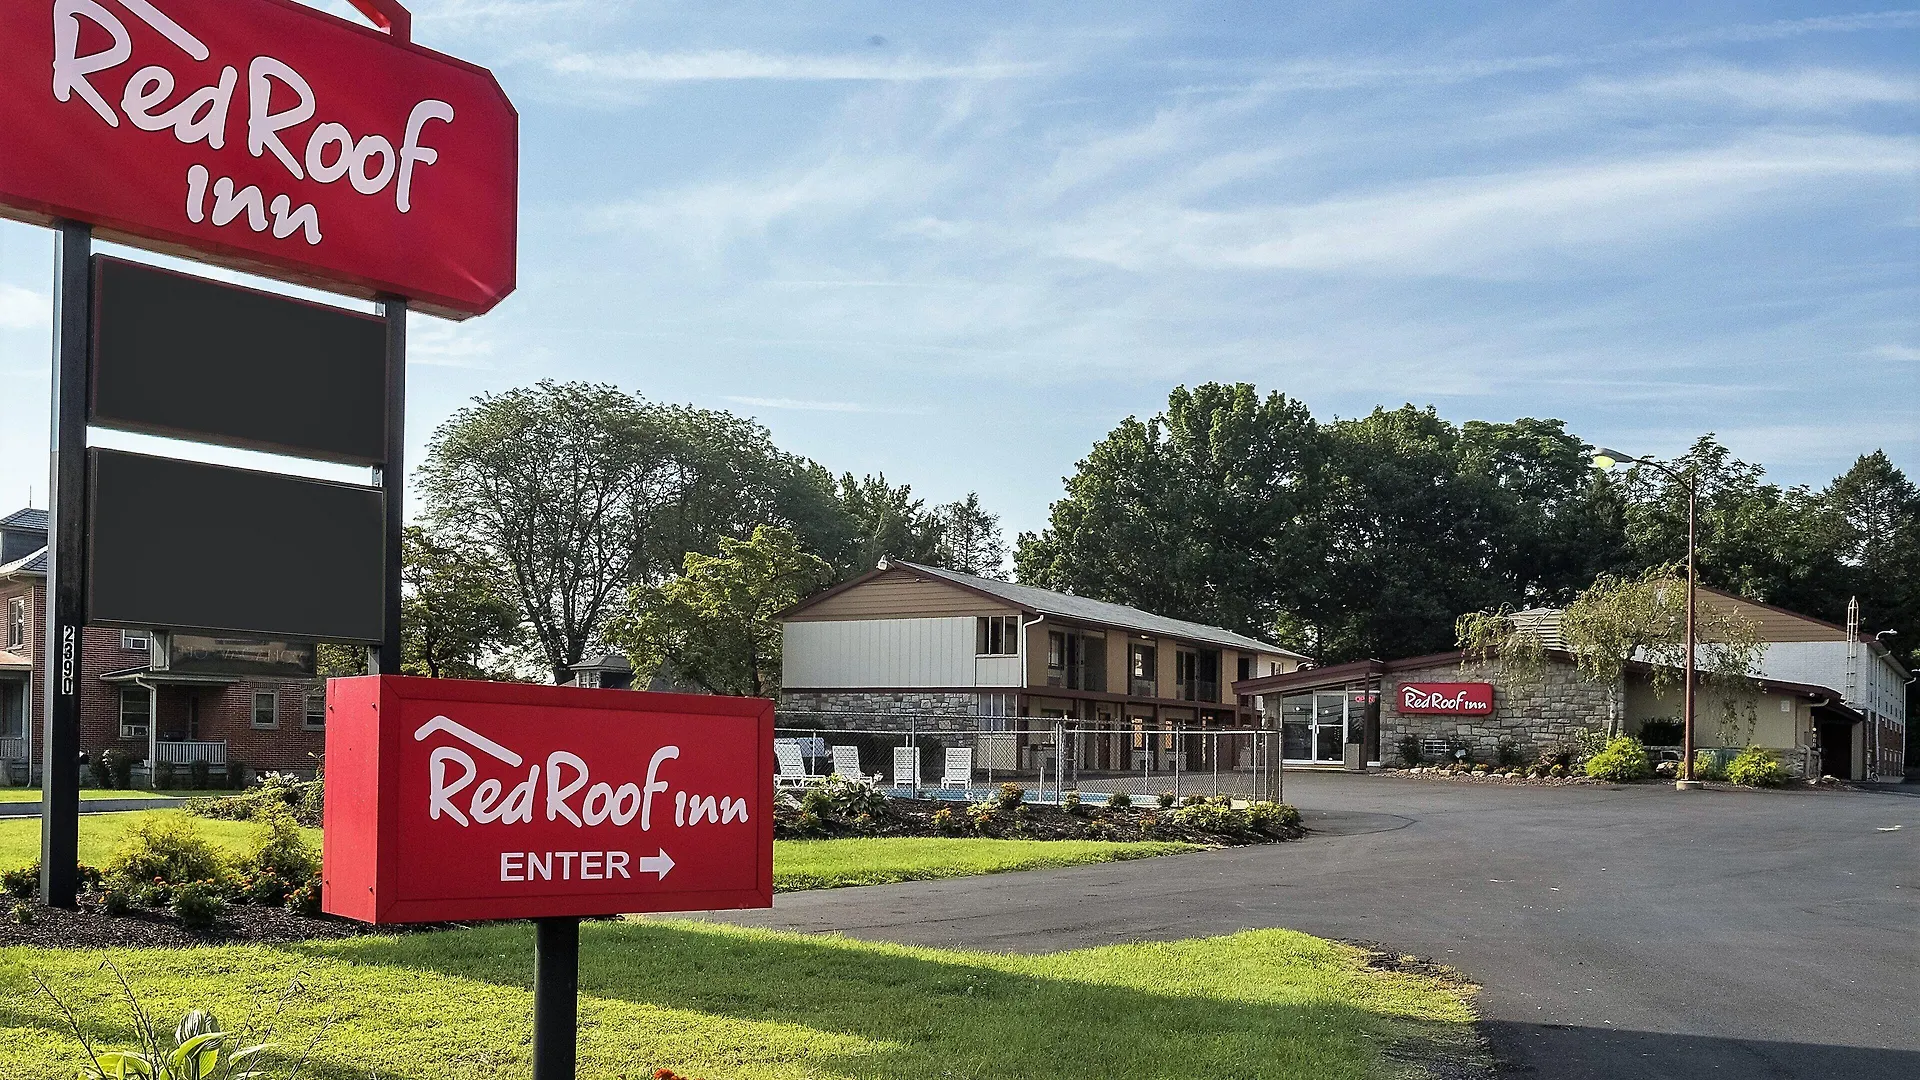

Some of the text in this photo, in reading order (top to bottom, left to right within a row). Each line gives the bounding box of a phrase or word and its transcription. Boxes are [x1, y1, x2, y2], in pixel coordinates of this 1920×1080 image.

[62, 625, 75, 695] 2390
[1355, 695, 1375, 703] OPN
[500, 851, 631, 882] ENTER
